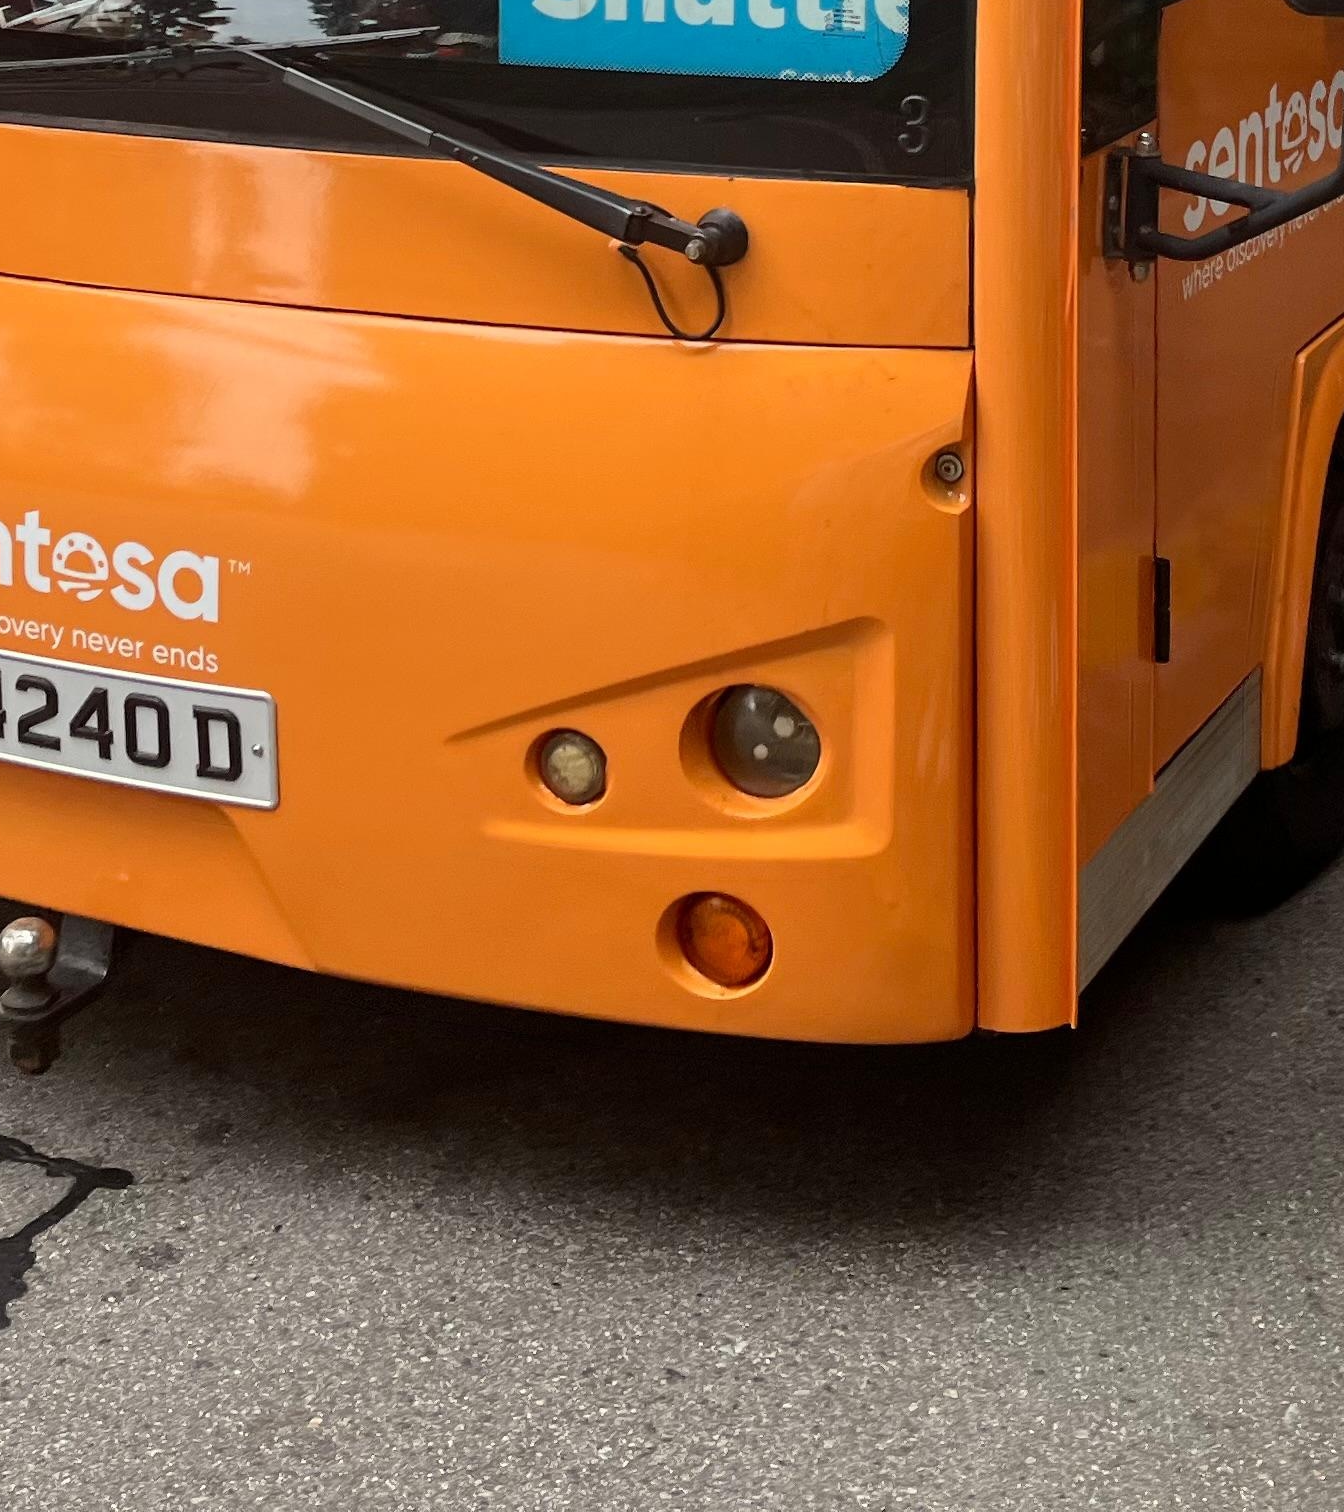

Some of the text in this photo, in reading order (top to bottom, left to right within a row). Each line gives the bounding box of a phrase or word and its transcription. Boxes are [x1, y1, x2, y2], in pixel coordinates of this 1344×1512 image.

[1181, 255, 1226, 301] where
[71, 629, 145, 659] never
[152, 645, 219, 673] ends
[192, 704, 243, 782] D
